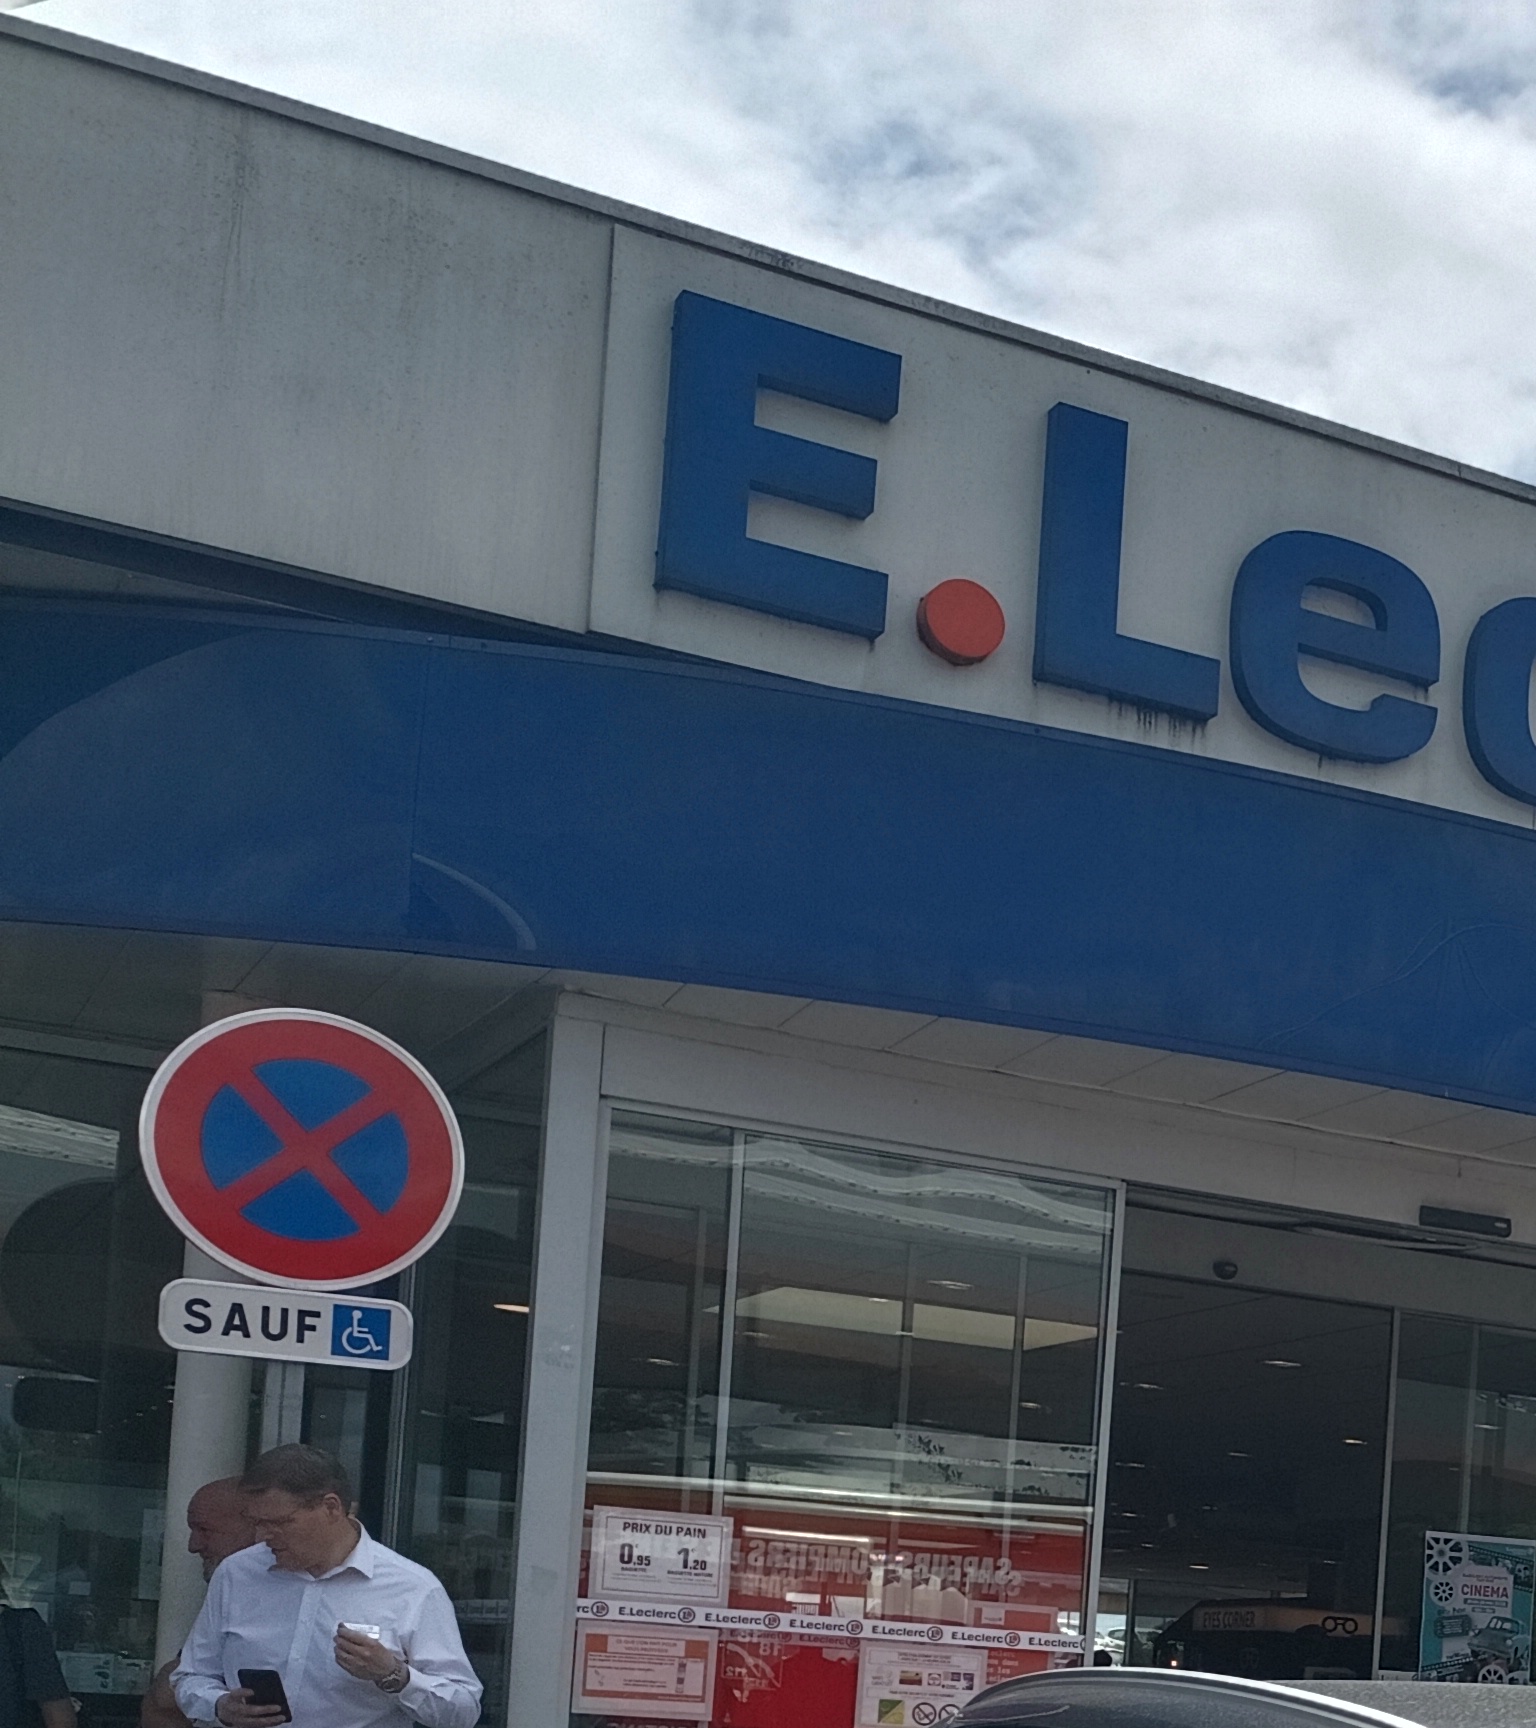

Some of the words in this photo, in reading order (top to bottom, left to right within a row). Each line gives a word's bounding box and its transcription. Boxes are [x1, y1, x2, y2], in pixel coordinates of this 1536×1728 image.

[183, 1297, 322, 1344] SAUF
[622, 1521, 651, 1534] PRIX
[654, 1525, 672, 1536] DU
[676, 1527, 706, 1539] PAIN
[1461, 1584, 1509, 1599] CINEMA
[619, 1606, 676, 1619] E.Leclerc
[705, 1613, 762, 1625] E.Leclerc
[789, 1619, 845, 1632] E.Leclerc
[872, 1625, 925, 1638] E.Leclerc
[951, 1631, 1003, 1644] E.Leclerc
[1029, 1637, 1079, 1649] E.Leclerc
